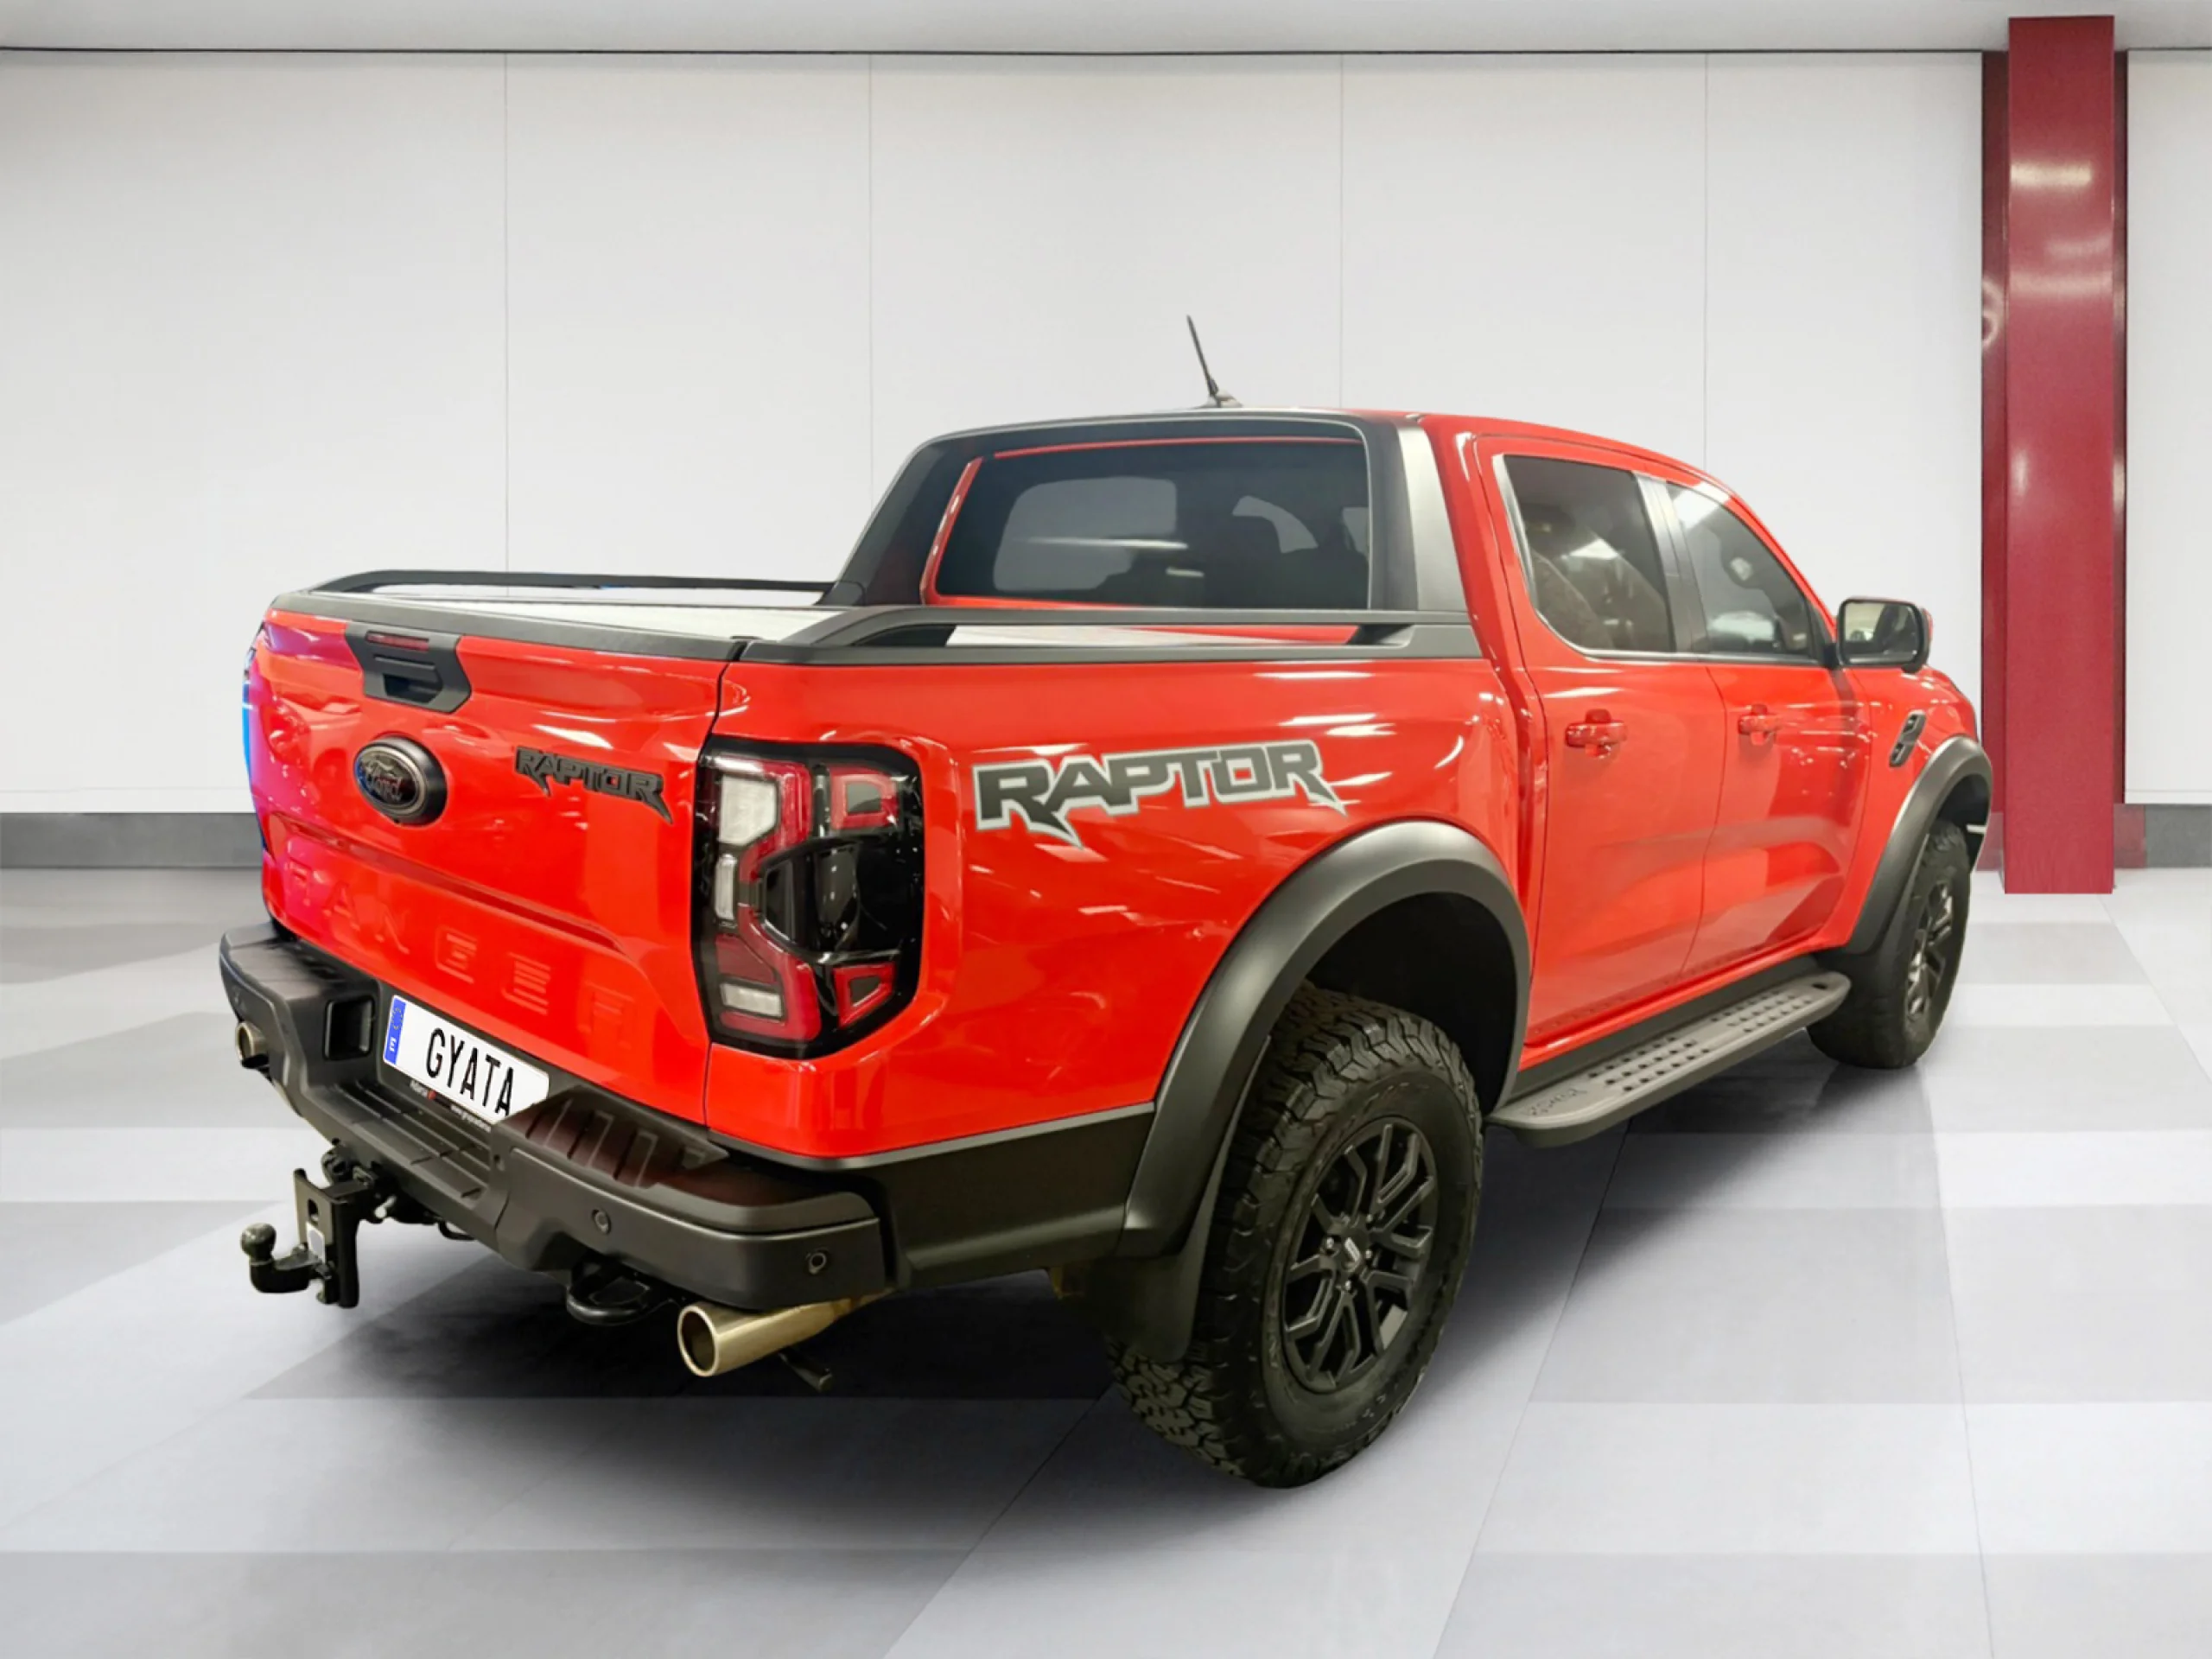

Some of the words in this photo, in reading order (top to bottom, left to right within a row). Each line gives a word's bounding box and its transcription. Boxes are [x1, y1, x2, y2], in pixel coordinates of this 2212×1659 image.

[516, 746, 672, 824] RAPTOR
[972, 739, 1349, 849] RAPTOR
[426, 1027, 514, 1116] GYATA
